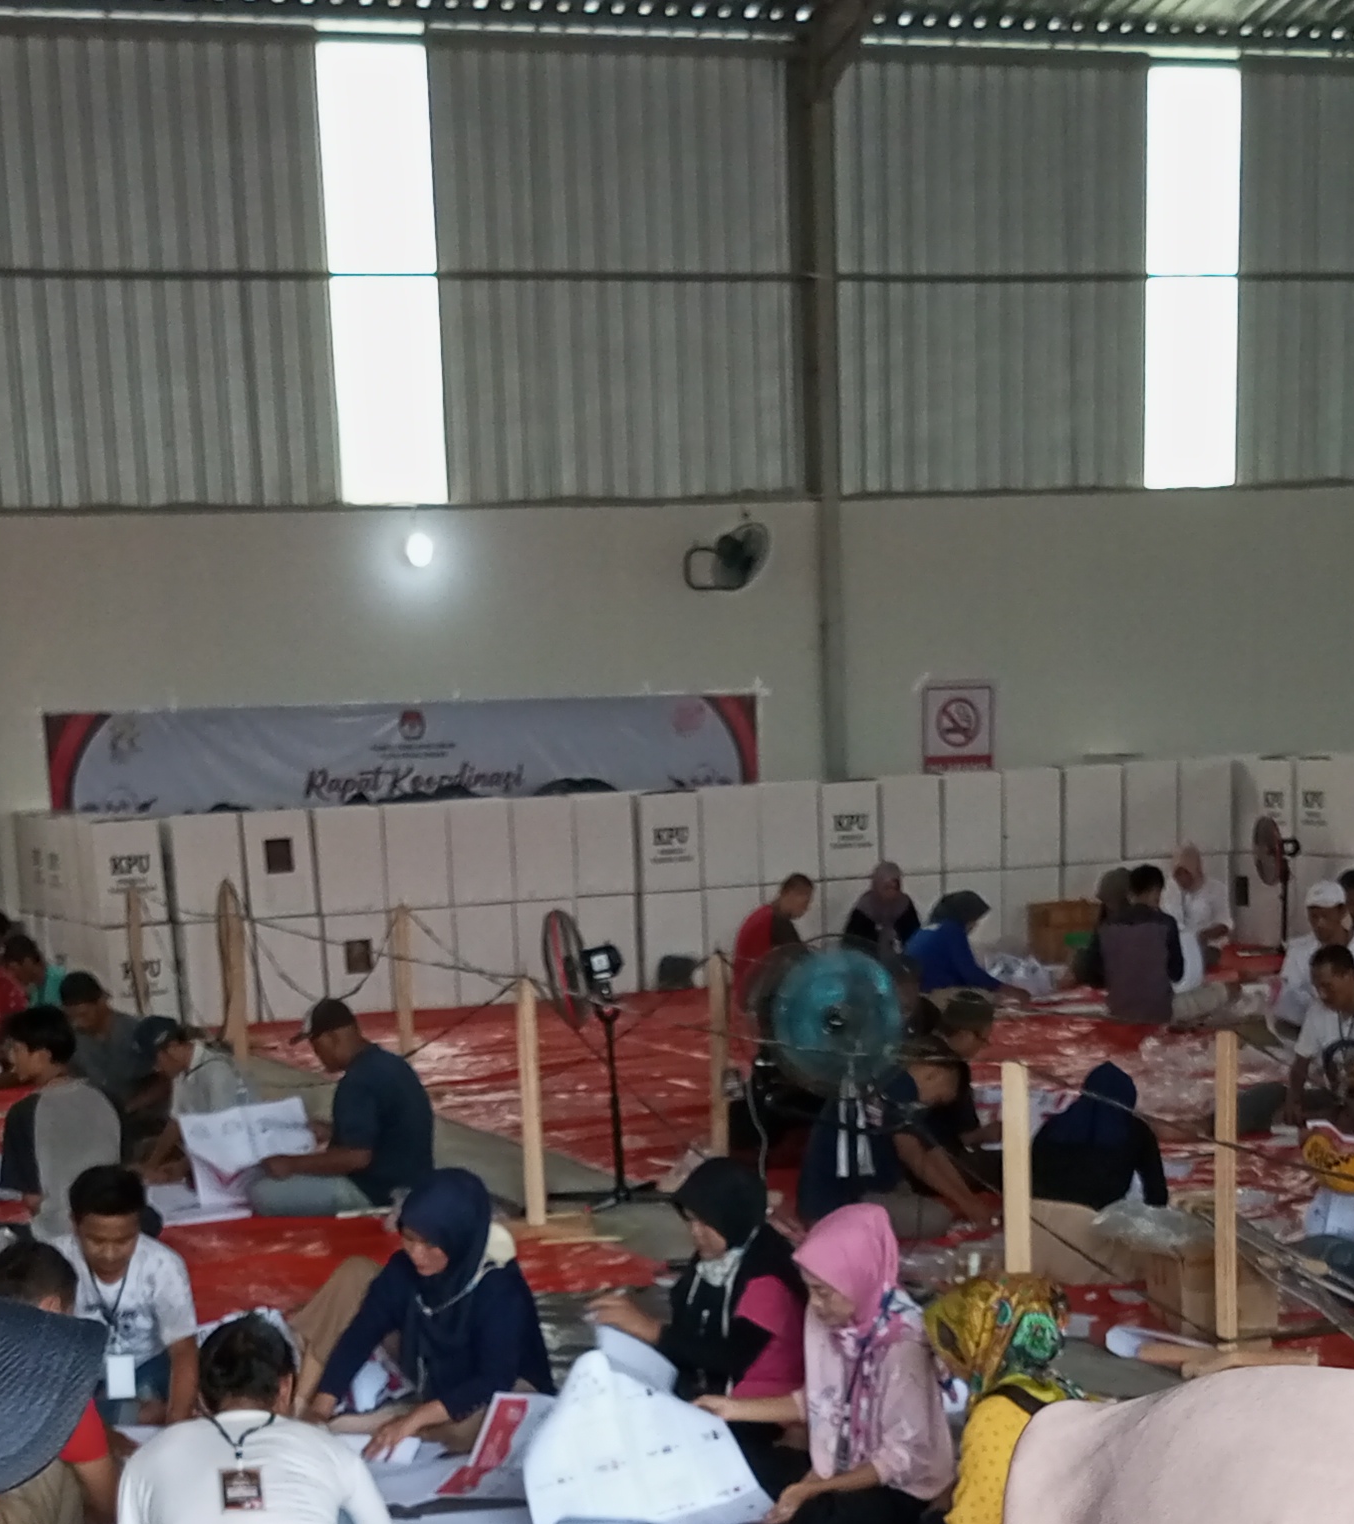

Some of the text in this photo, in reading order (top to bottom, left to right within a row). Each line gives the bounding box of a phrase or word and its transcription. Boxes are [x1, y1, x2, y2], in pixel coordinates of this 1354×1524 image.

[303, 765, 387, 801] Rapat
[833, 814, 869, 831] KPU
[652, 826, 690, 846] KPU
[110, 854, 151, 876] KPU
